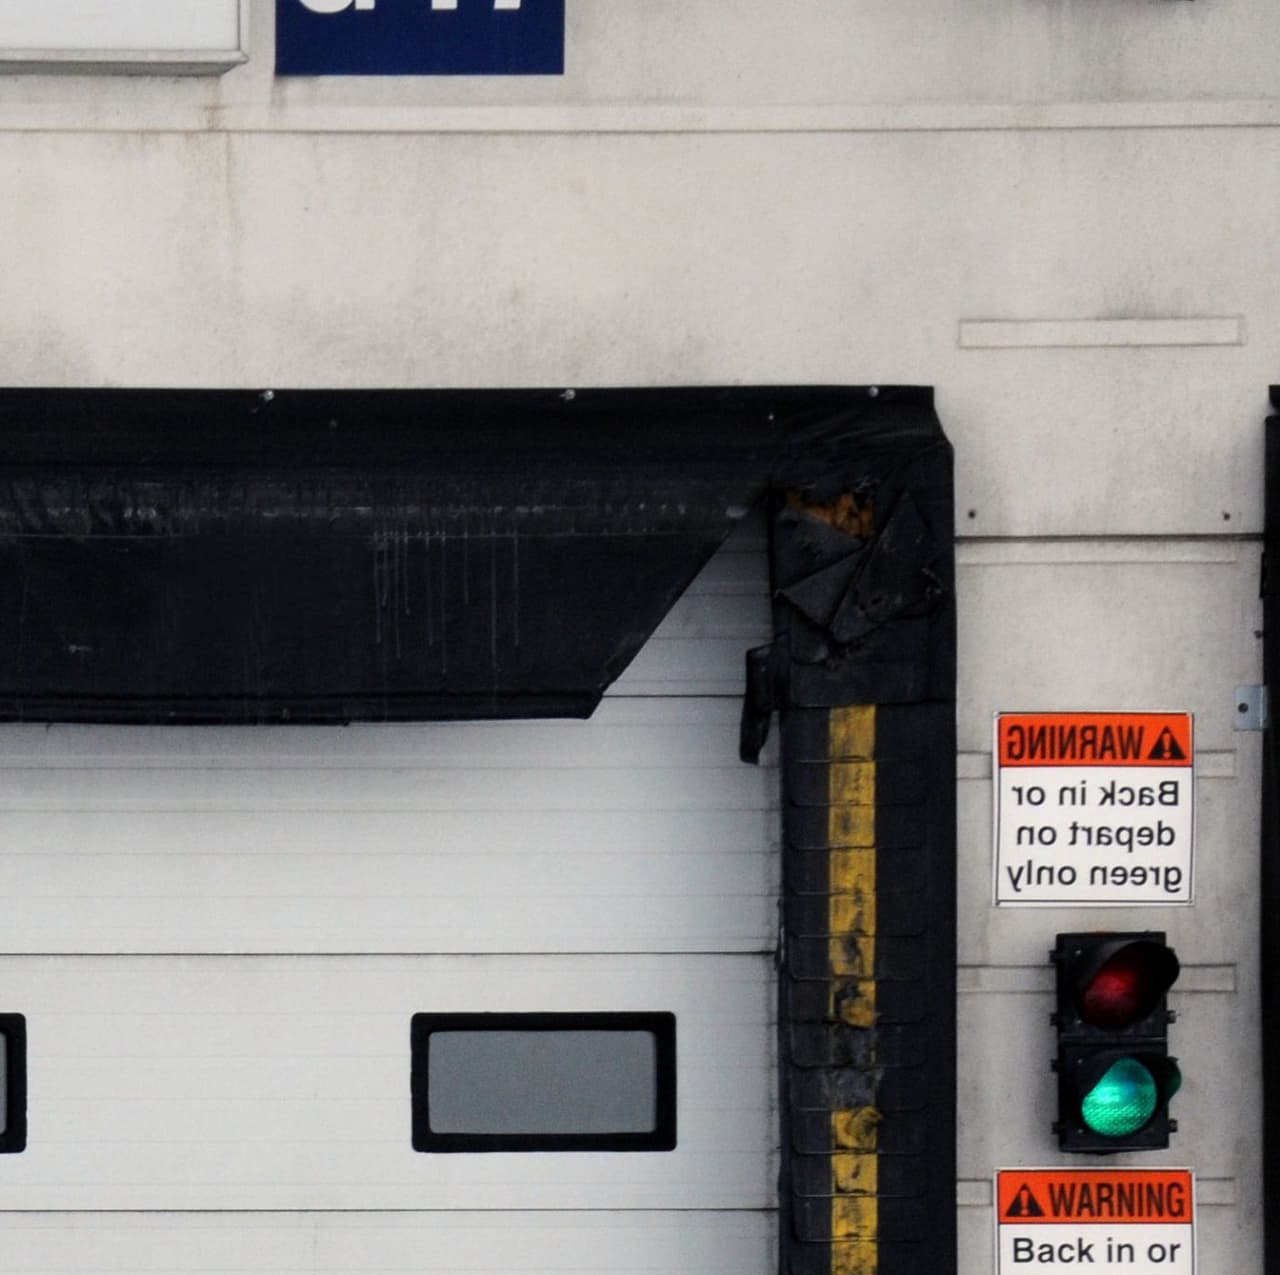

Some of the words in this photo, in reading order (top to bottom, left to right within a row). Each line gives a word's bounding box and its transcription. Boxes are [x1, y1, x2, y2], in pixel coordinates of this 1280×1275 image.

[1047, 1181, 1185, 1218] WARNING
[1013, 1237, 1095, 1264] Back
[1107, 1237, 1135, 1263] in
[1147, 1243, 1181, 1264] or
